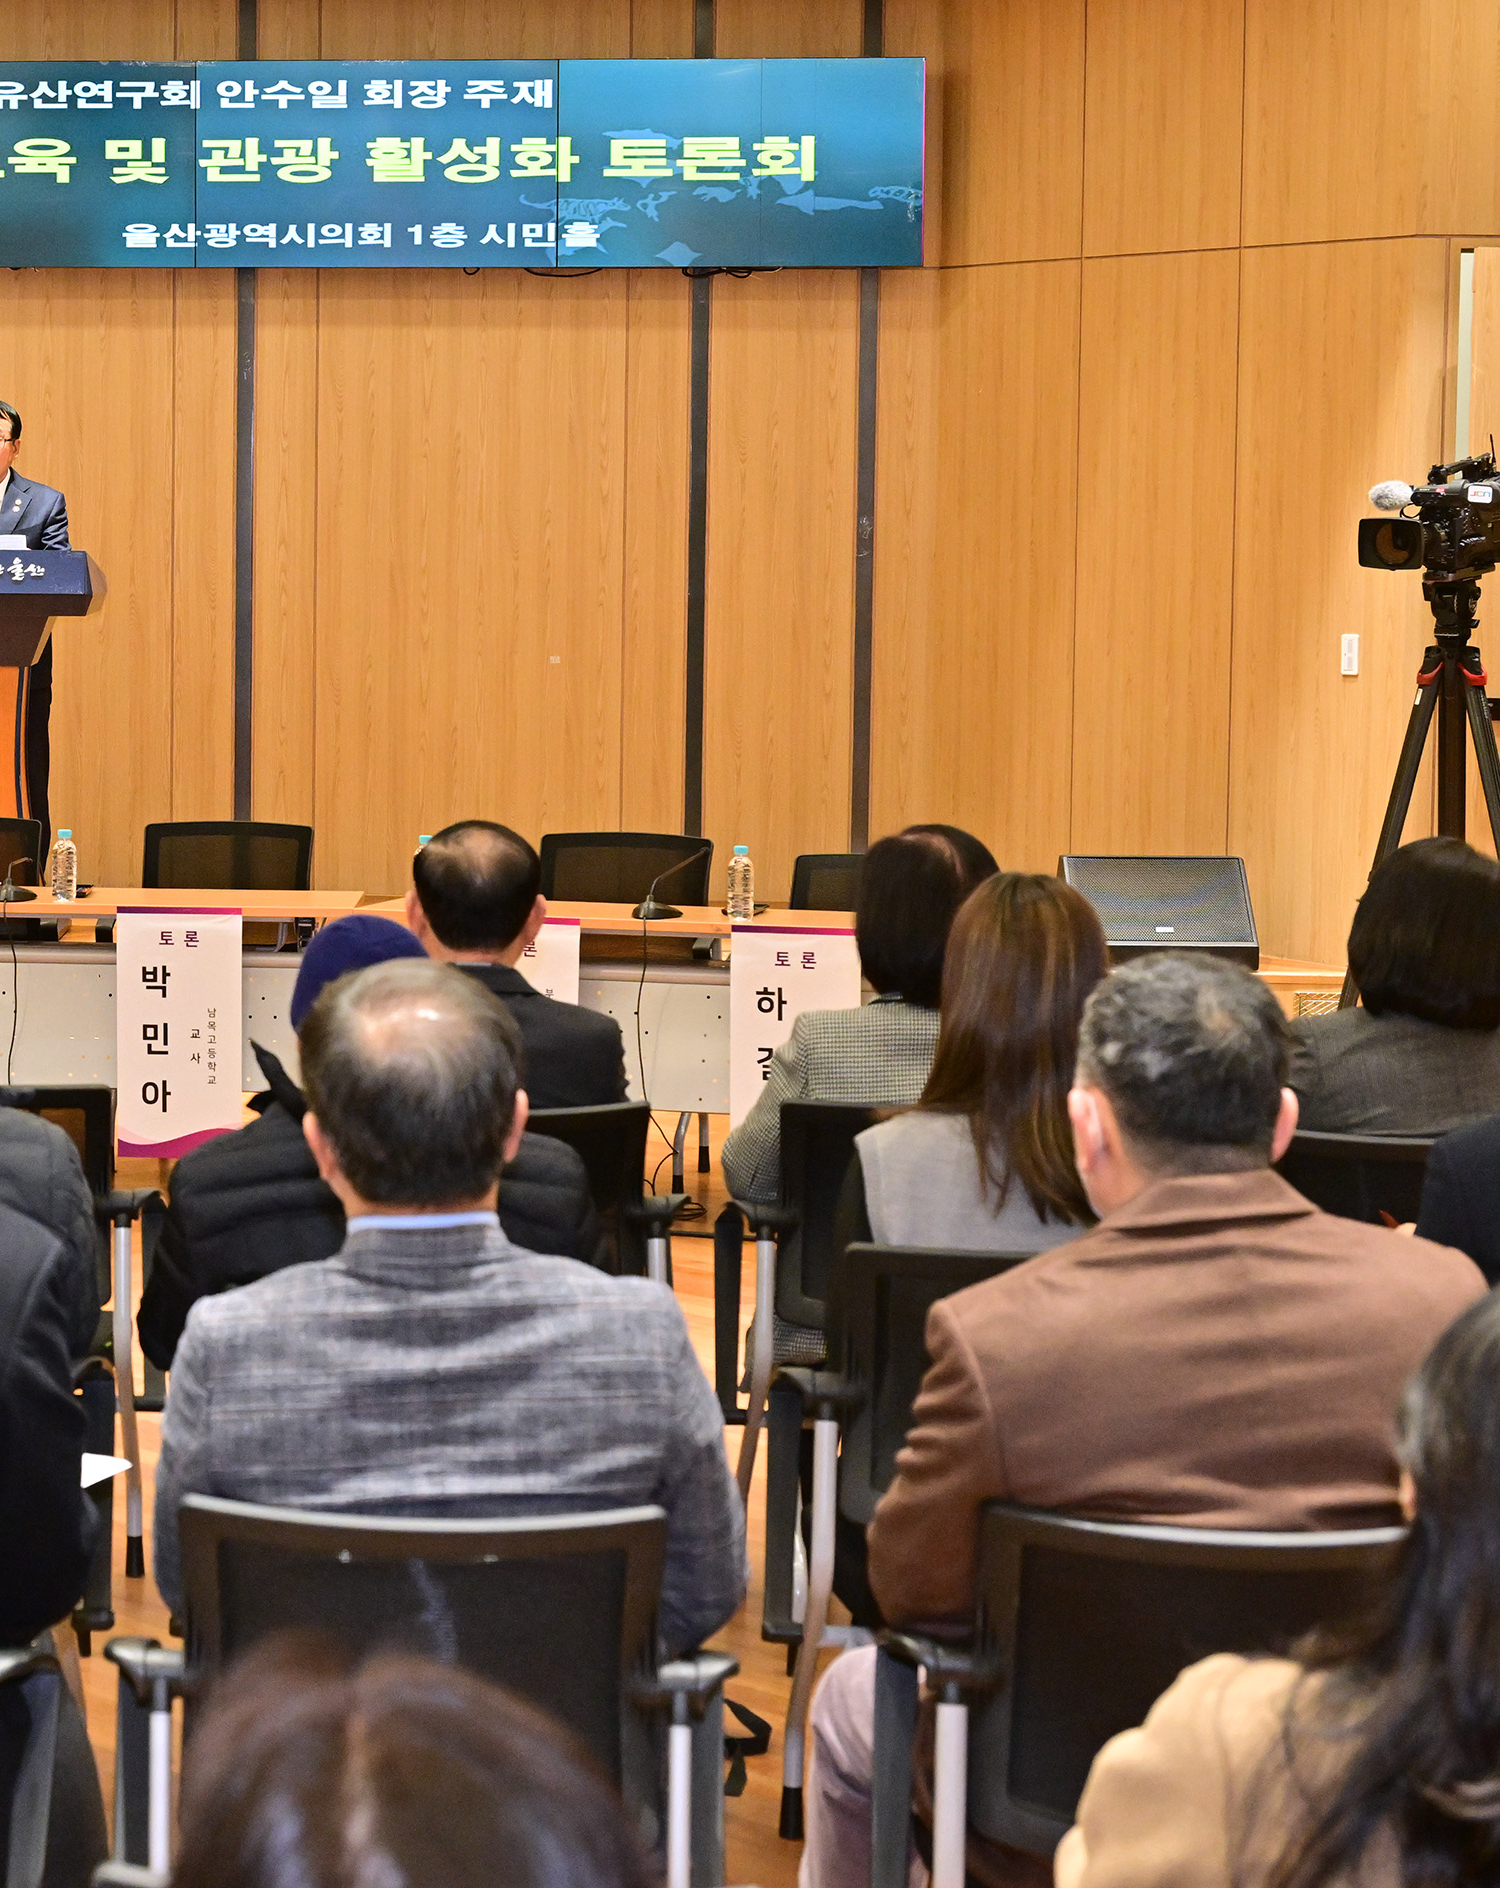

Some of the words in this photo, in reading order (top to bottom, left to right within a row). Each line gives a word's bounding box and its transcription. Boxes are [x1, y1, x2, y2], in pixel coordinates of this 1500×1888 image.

[216, 79, 348, 109] 안수일
[363, 79, 452, 109] 회장
[463, 78, 553, 109] 주재
[104, 136, 170, 184] 및
[198, 136, 341, 184] 관광
[365, 136, 581, 183] 활성화
[602, 135, 816, 183] 토론회
[122, 222, 392, 248] 울산광역시의회
[406, 222, 468, 248] 1층
[479, 221, 601, 248] 시민홀
[6, 556, 46, 581] 울산
[141, 964, 172, 1113] 박민아
[189, 1028, 202, 1065] 교사
